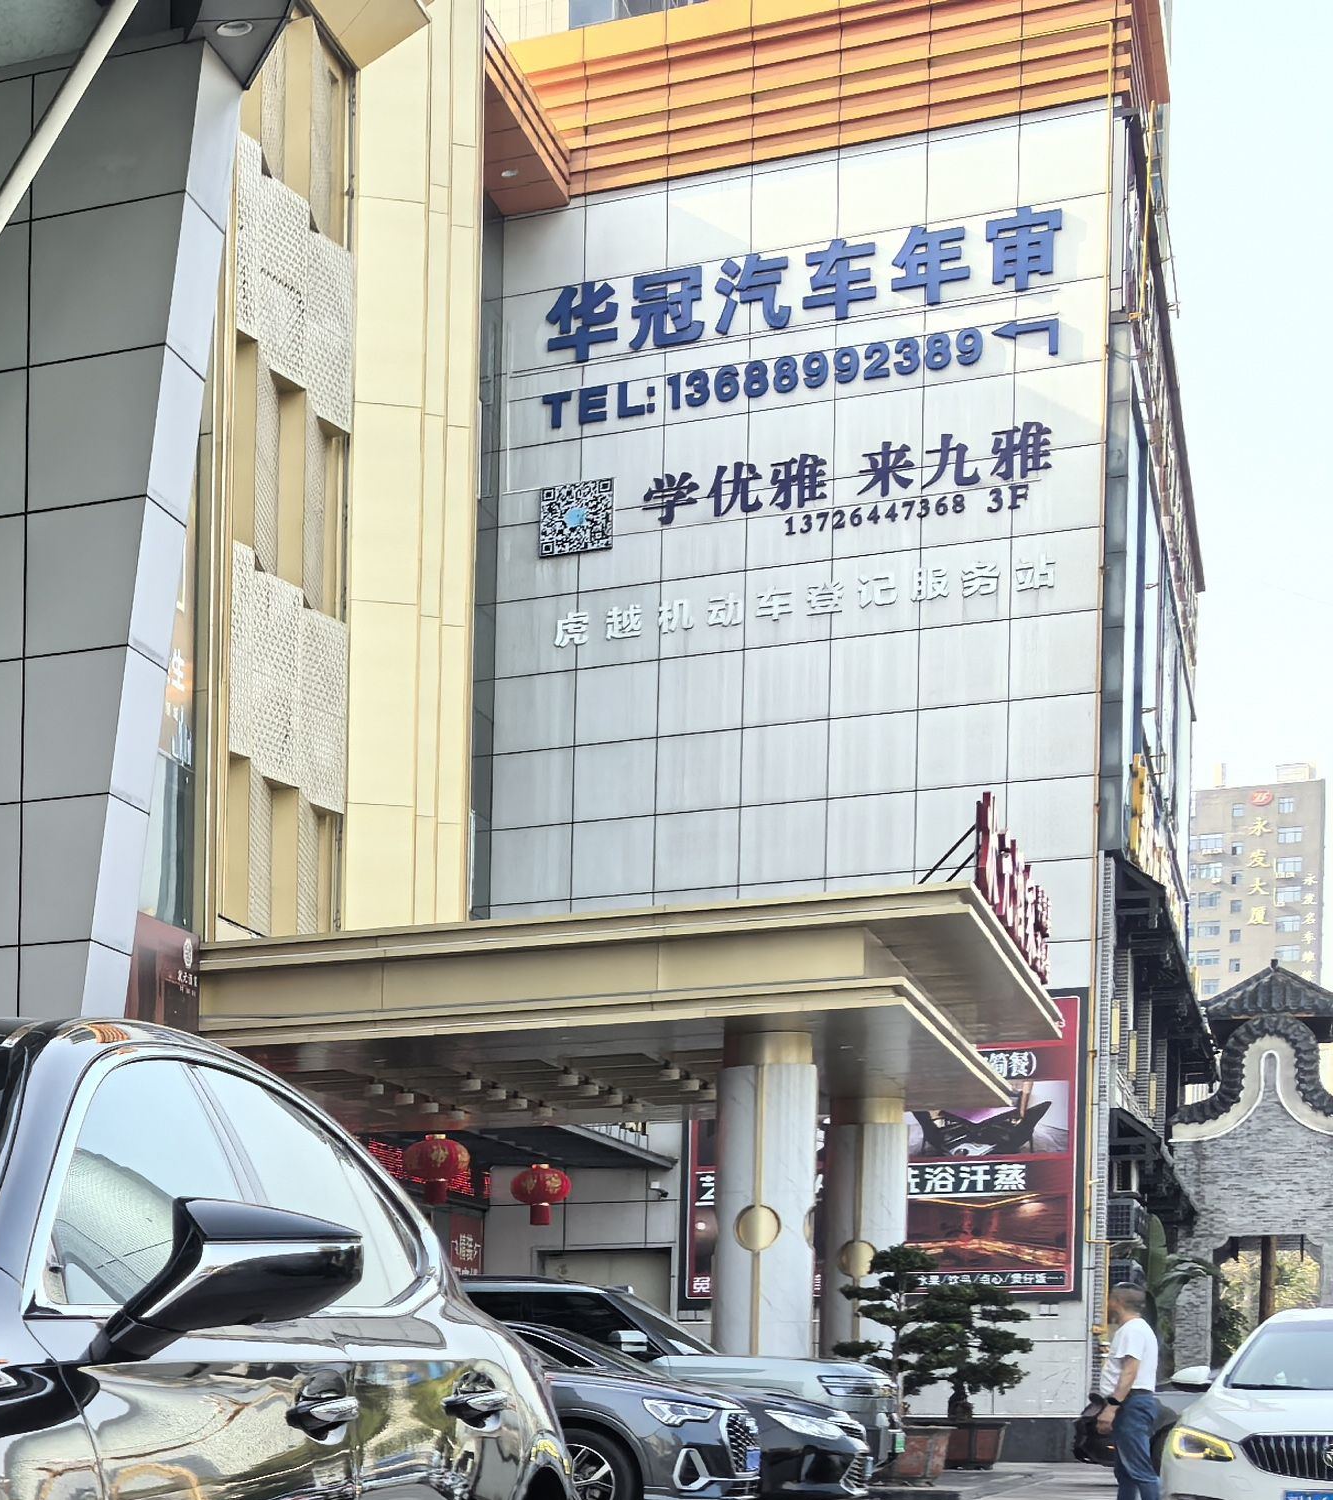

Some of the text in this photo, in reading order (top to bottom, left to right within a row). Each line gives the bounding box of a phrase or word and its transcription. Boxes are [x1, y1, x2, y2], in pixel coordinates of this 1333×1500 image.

[544, 206, 1063, 362] 华冠汽车年审
[542, 327, 984, 429] TEL:13688992389
[642, 421, 1053, 525] 学优雅 来九雅
[784, 483, 1030, 537] 13726447368 3F
[553, 555, 1056, 647] 虎越机动车登记服务站
[983, 1051, 1037, 1078] 简餐)
